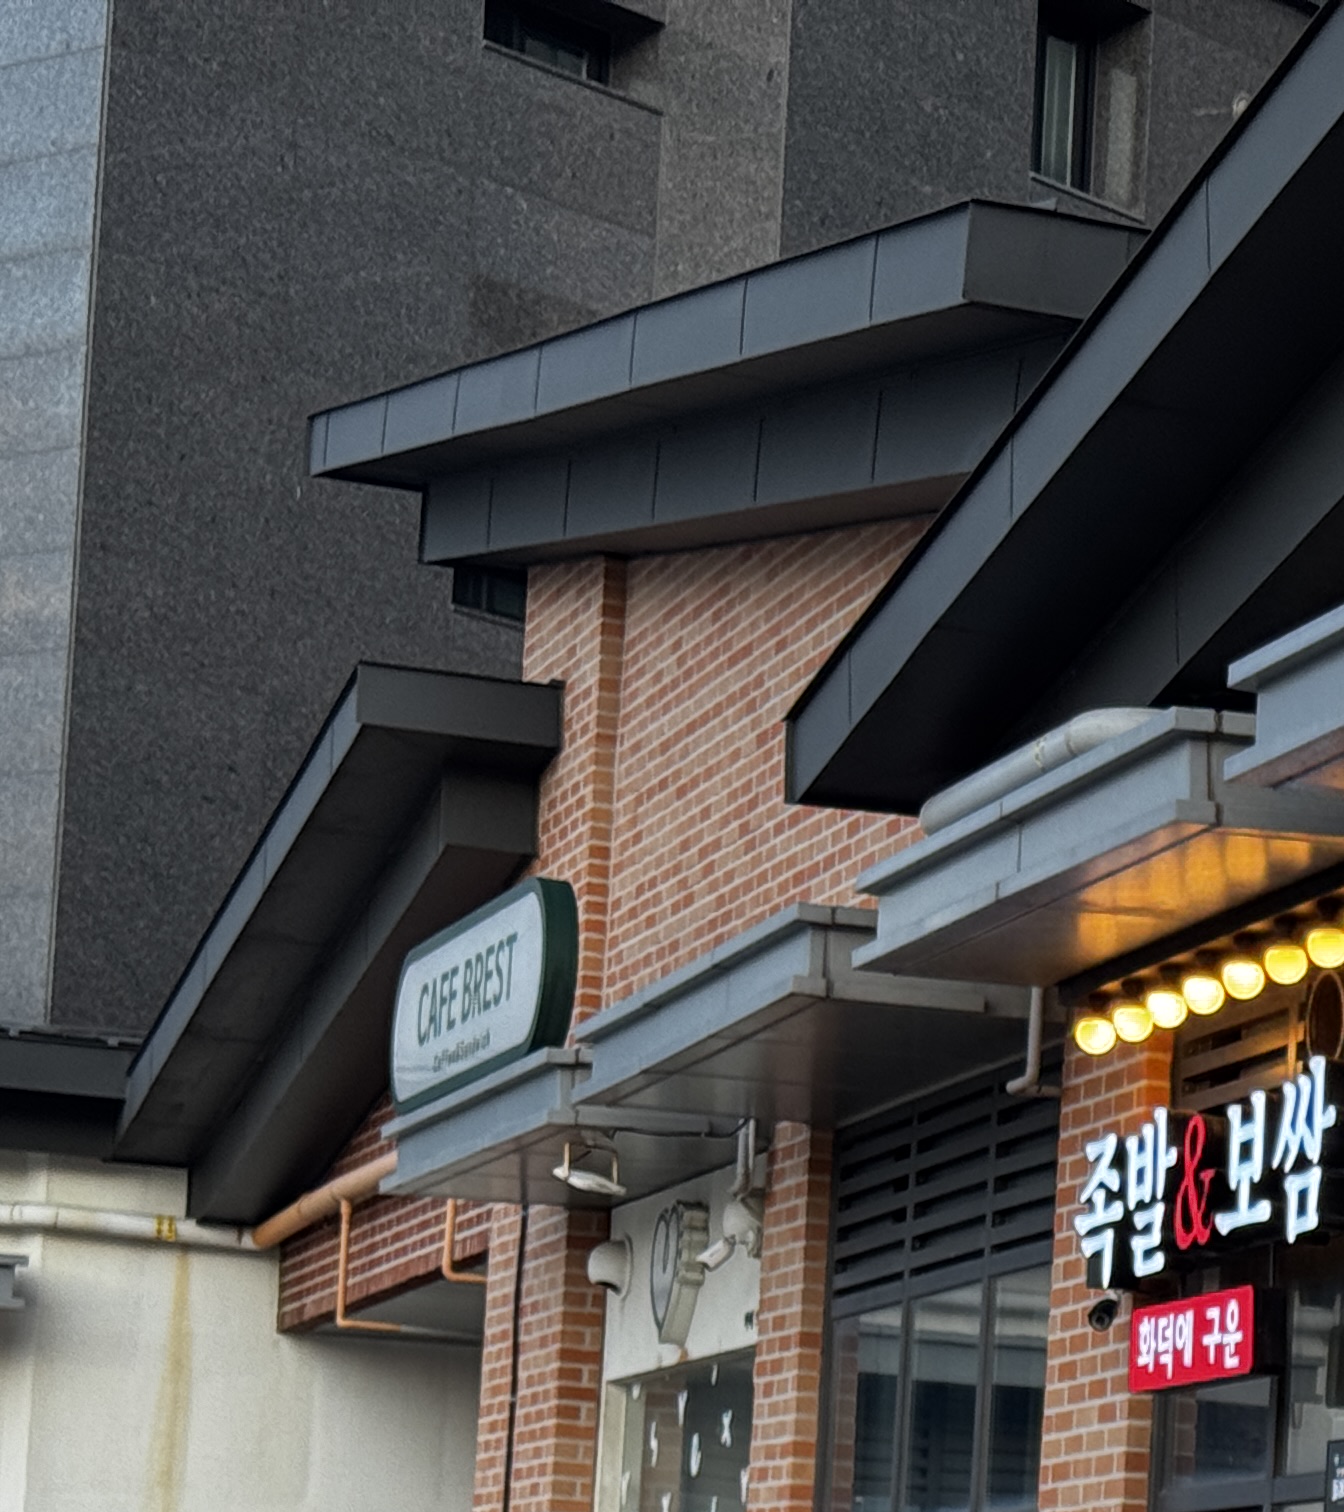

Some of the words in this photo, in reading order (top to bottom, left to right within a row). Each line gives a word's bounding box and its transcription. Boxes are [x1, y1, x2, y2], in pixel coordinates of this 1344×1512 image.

[417, 965, 460, 1047] CAFE
[461, 931, 519, 1025] BREST
[1135, 1307, 1195, 1381] 화덕에
[1202, 1298, 1243, 1368] 구운
